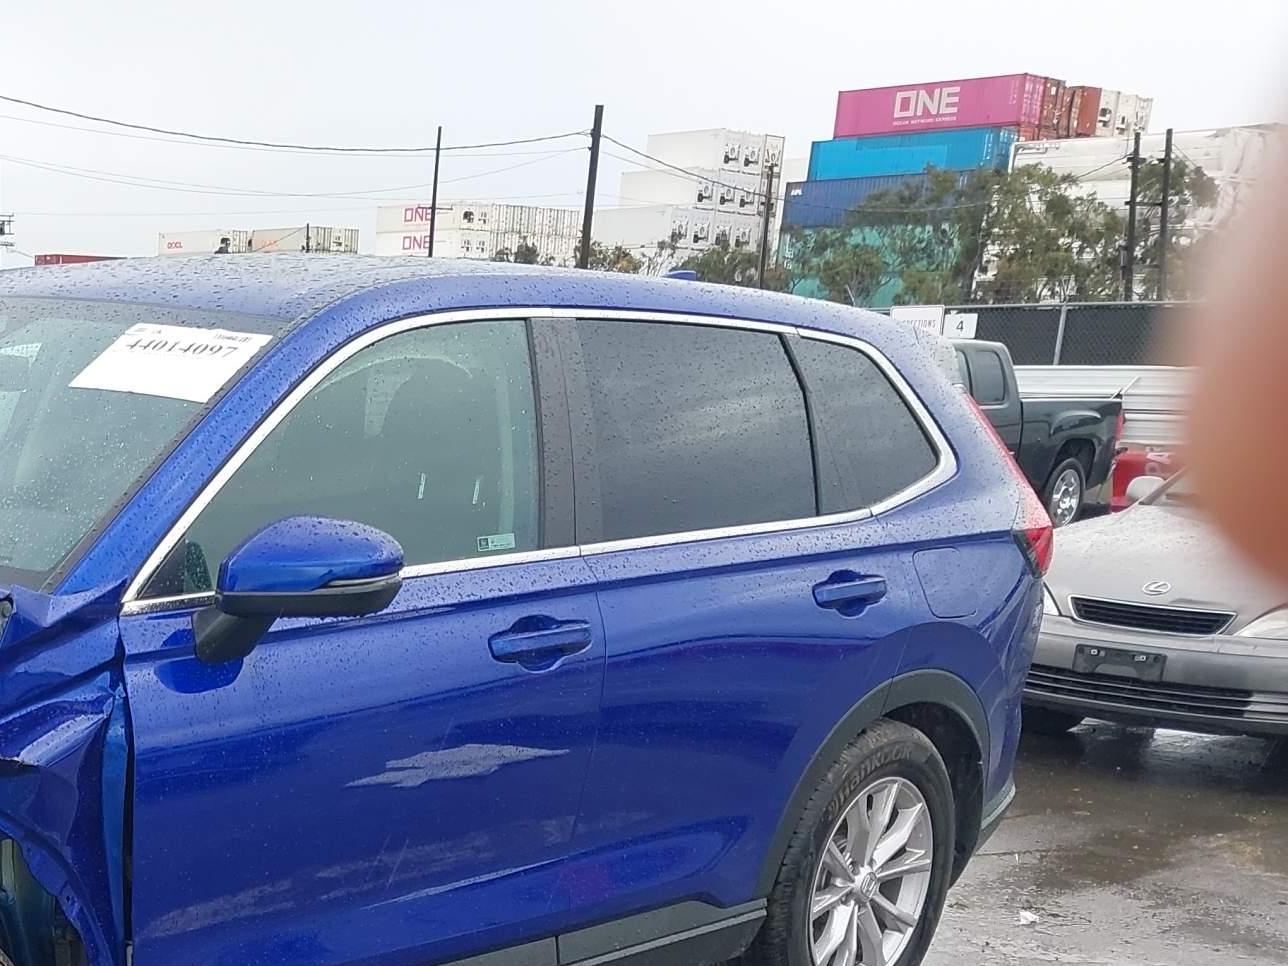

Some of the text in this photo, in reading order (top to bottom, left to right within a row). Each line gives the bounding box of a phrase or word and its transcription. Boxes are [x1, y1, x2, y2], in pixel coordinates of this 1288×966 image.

[893, 86, 961, 118] ONE
[955, 320, 964, 332] 4
[126, 338, 238, 357] 44014097
